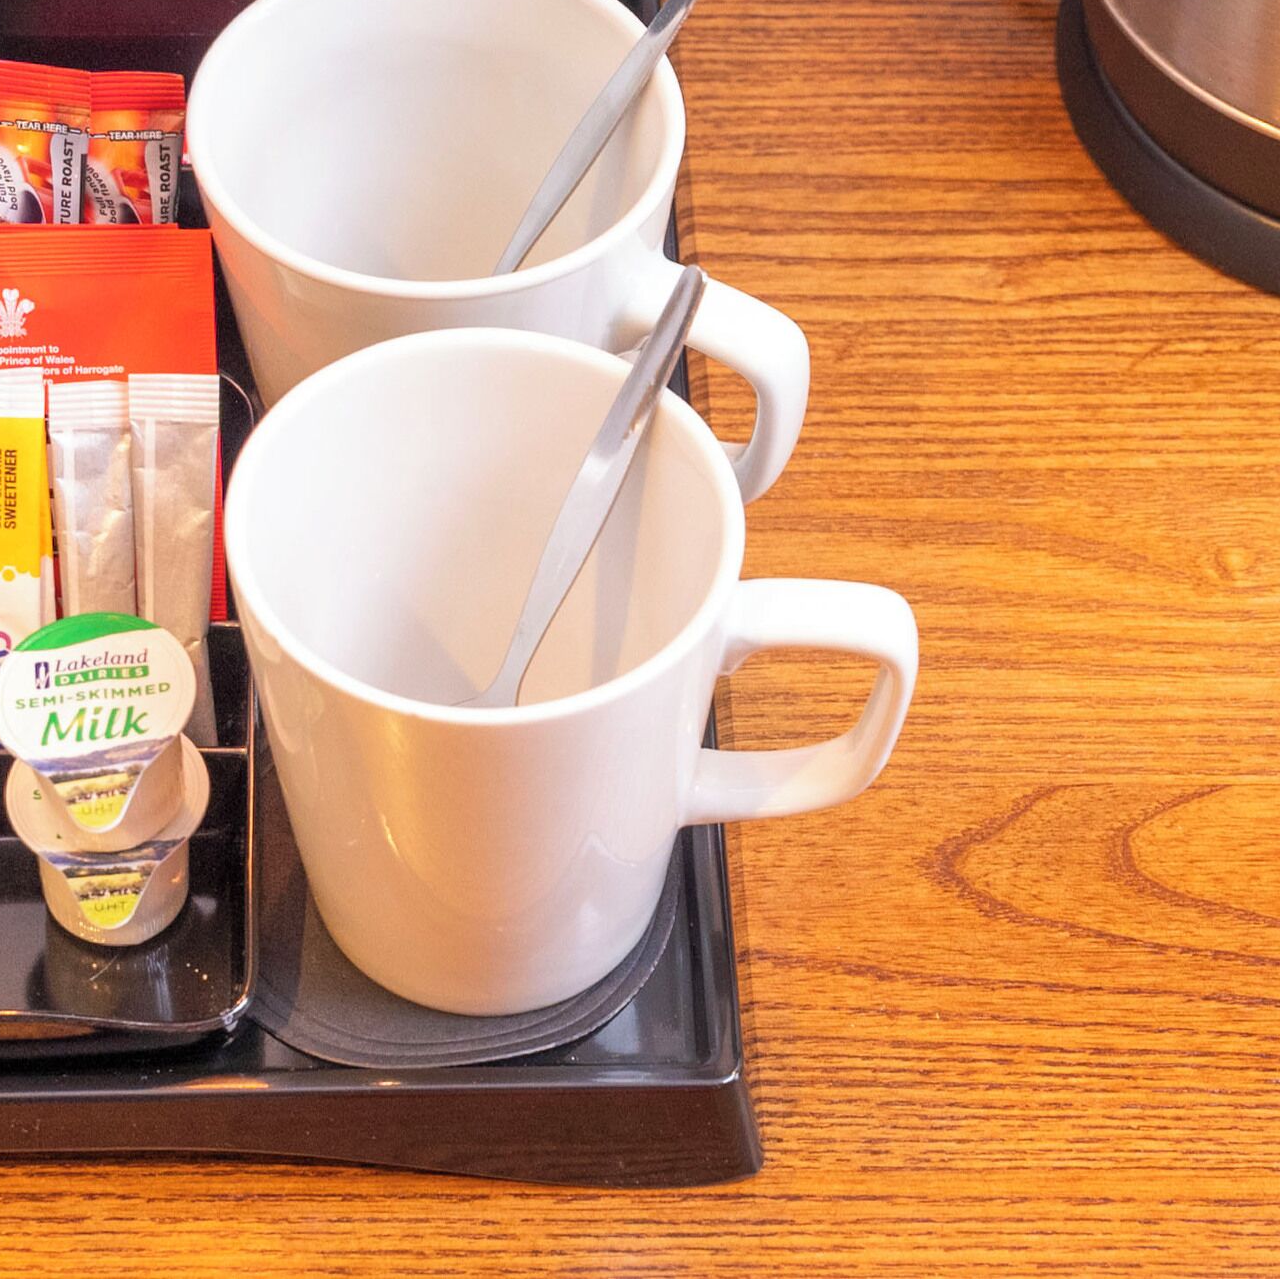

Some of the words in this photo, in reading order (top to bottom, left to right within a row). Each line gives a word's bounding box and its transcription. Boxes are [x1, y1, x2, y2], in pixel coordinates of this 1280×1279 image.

[16, 120, 41, 130] TEAR
[42, 123, 69, 133] HERE
[109, 131, 135, 140] TEAR
[136, 131, 163, 140] HERE
[62, 138, 74, 186] ROAST
[160, 144, 171, 193] ROAST
[7, 186, 18, 210] bold
[32, 355, 43, 365] of
[45, 355, 75, 364] Wales
[49, 346, 59, 354] to
[62, 366, 73, 375] of
[75, 365, 125, 376] Harrogate
[4, 449, 17, 529] SWEETENER
[55, 648, 148, 673] Lakeland
[58, 667, 145, 686] DAIRIES
[15, 682, 171, 710] SEMI-SKIMMED
[41, 706, 148, 746] Milk
